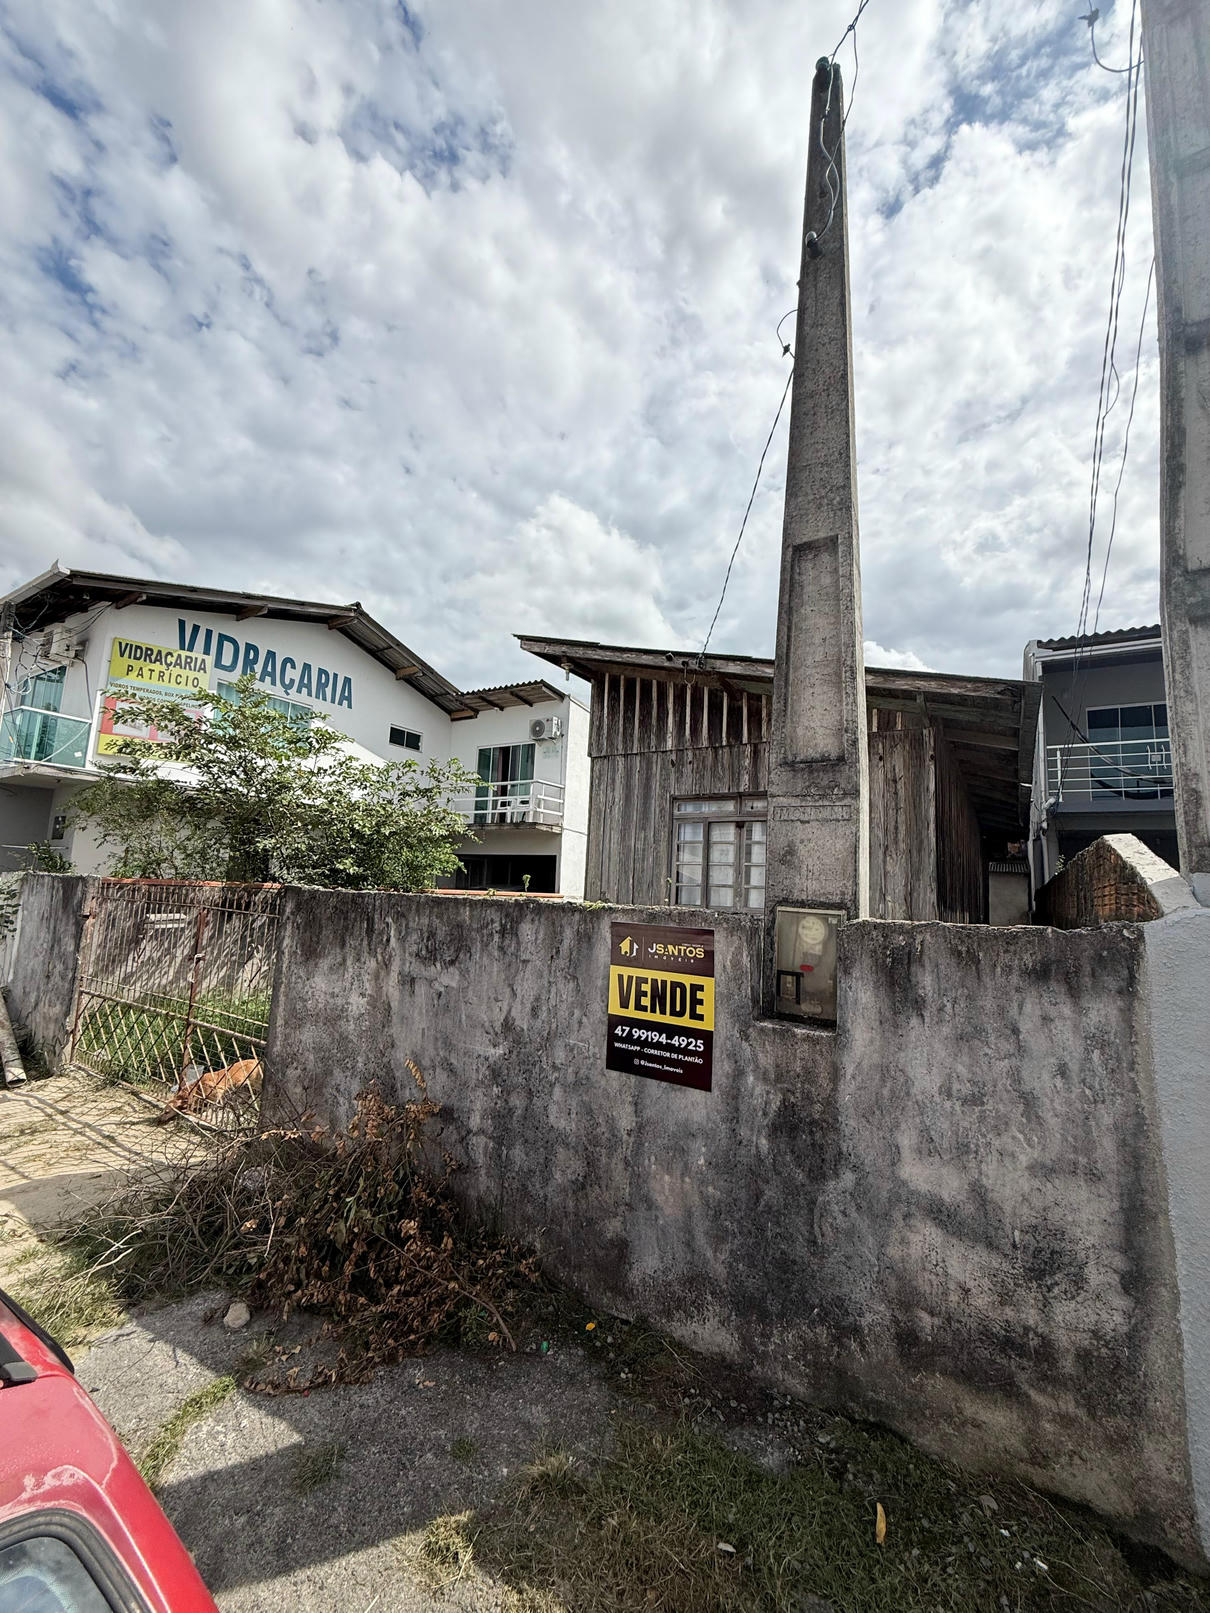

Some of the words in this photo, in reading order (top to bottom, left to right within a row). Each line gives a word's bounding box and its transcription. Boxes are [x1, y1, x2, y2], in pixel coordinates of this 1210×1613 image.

[118, 641, 207, 674] VIDRAÇARIA
[178, 618, 353, 710] VIDRAÇARIA
[110, 682, 129, 690] VIDROS
[126, 664, 200, 688] PATRÍCIO
[617, 973, 704, 1022] VENDE
[614, 1025, 630, 1037] 47
[632, 1028, 704, 1051] 99194-4925
[614, 1042, 641, 1051] WHATSAPP
[644, 1047, 670, 1058] CORRETOR
[678, 1055, 704, 1064] PLANTÃO
